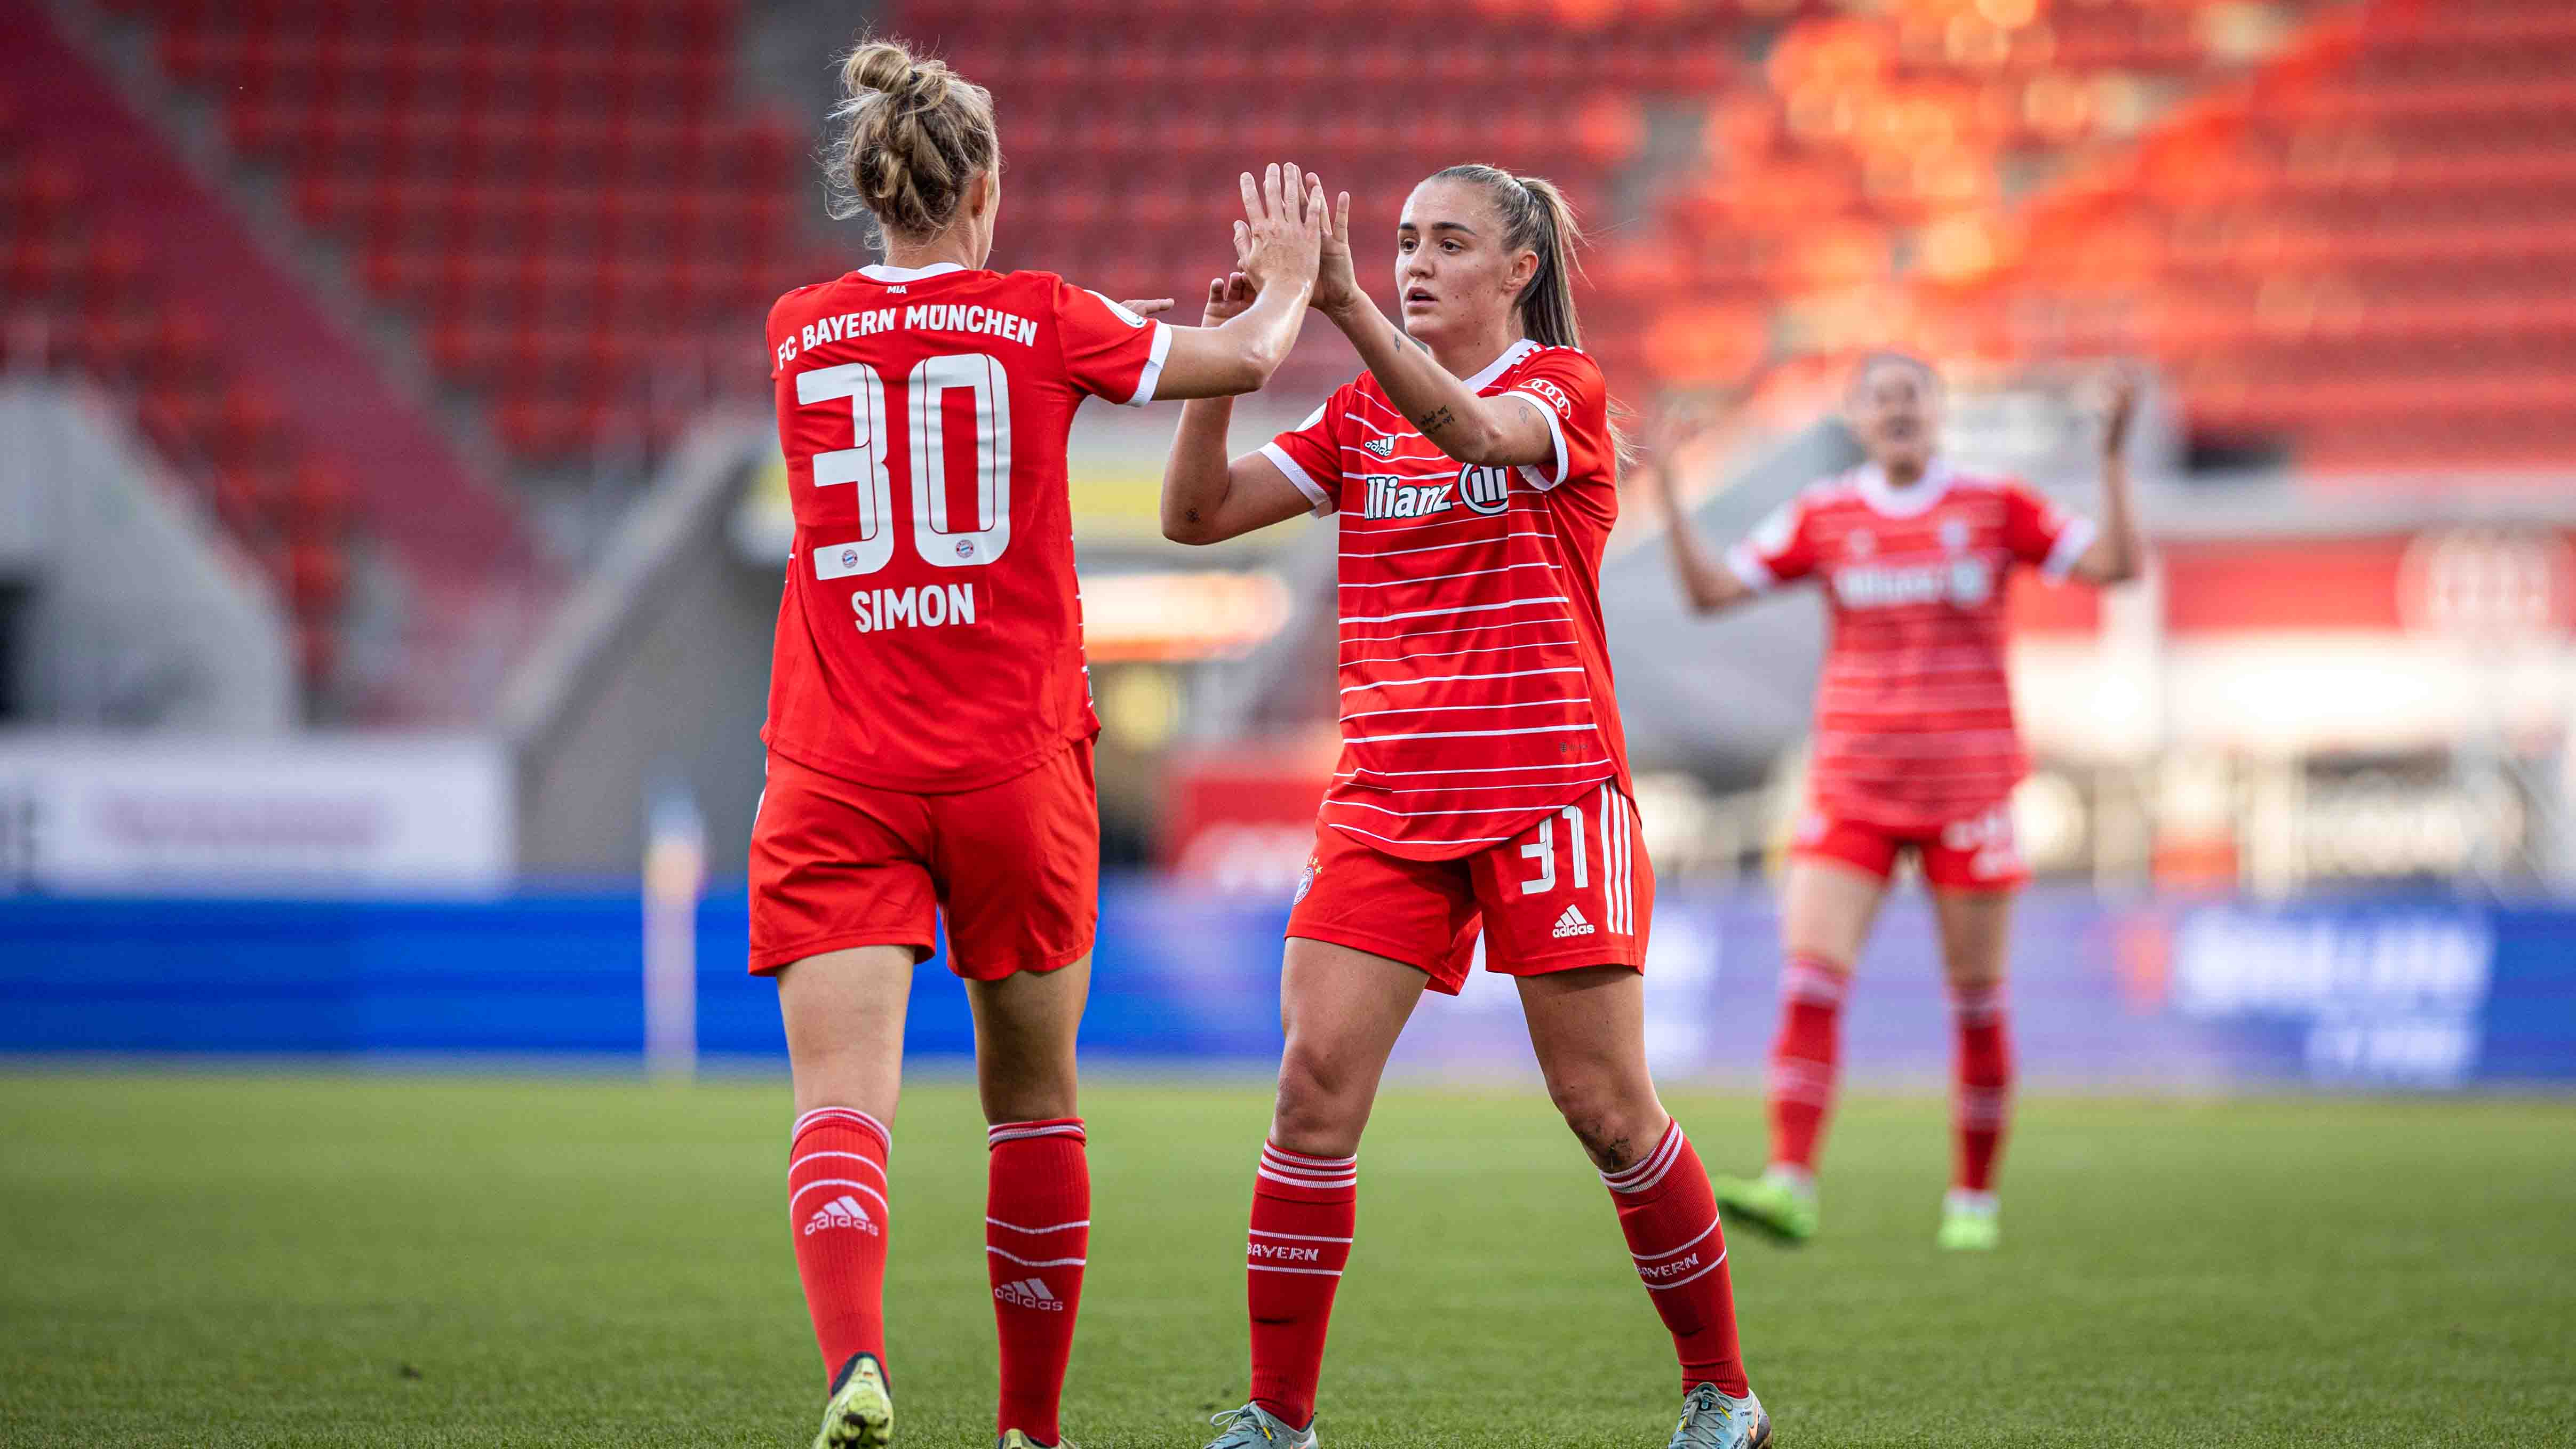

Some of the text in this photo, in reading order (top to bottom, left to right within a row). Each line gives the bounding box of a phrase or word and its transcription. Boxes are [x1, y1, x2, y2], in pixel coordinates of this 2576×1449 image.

[887, 285, 907, 294] MIA
[777, 305, 1038, 371] FC BAYERN MÜNCHEN
[796, 353, 1011, 581] 30
[1365, 476, 1454, 520] llianz
[851, 583, 976, 634] SIMON
[1521, 805, 1589, 895] 31
[1552, 924, 1595, 938] adidas
[804, 1214, 879, 1236] adidas
[994, 1287, 1063, 1311] adidas
